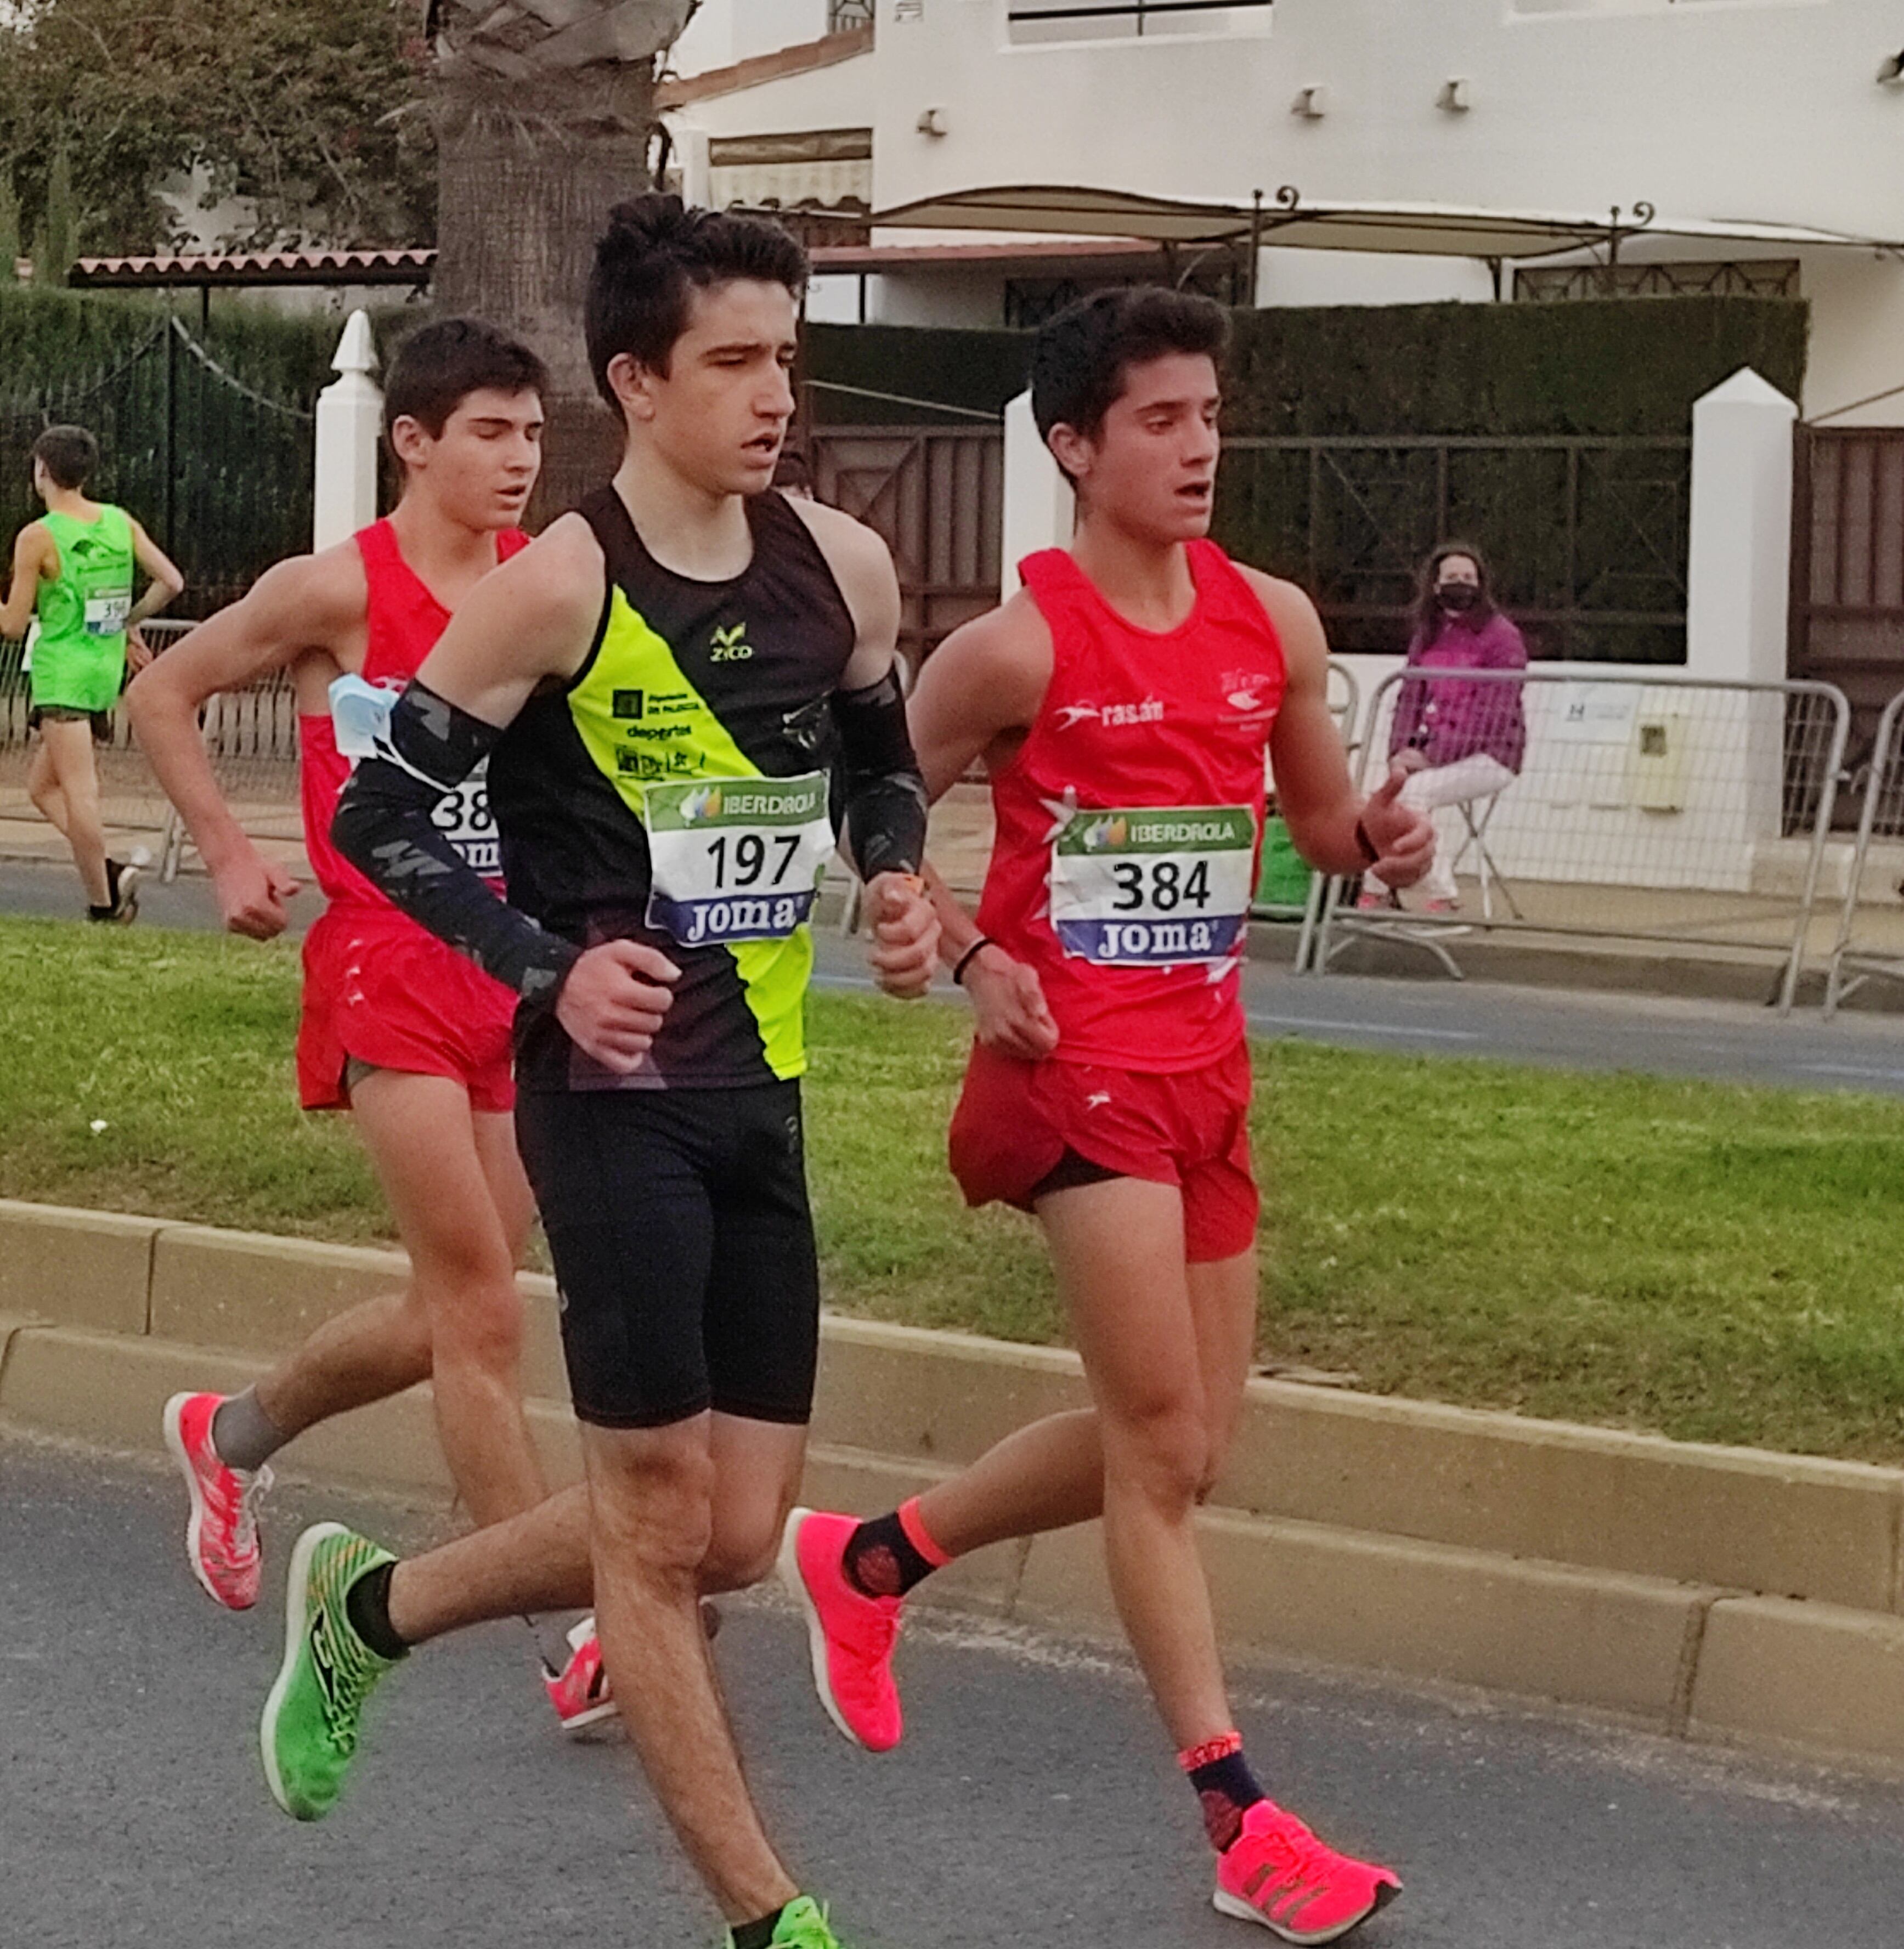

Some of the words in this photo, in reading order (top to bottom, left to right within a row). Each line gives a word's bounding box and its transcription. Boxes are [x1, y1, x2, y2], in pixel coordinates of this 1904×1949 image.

[1101, 693, 1164, 727] rasán
[1131, 821, 1235, 843] IBERDROLA
[707, 834, 801, 889] 197
[1112, 860, 1211, 911] 384
